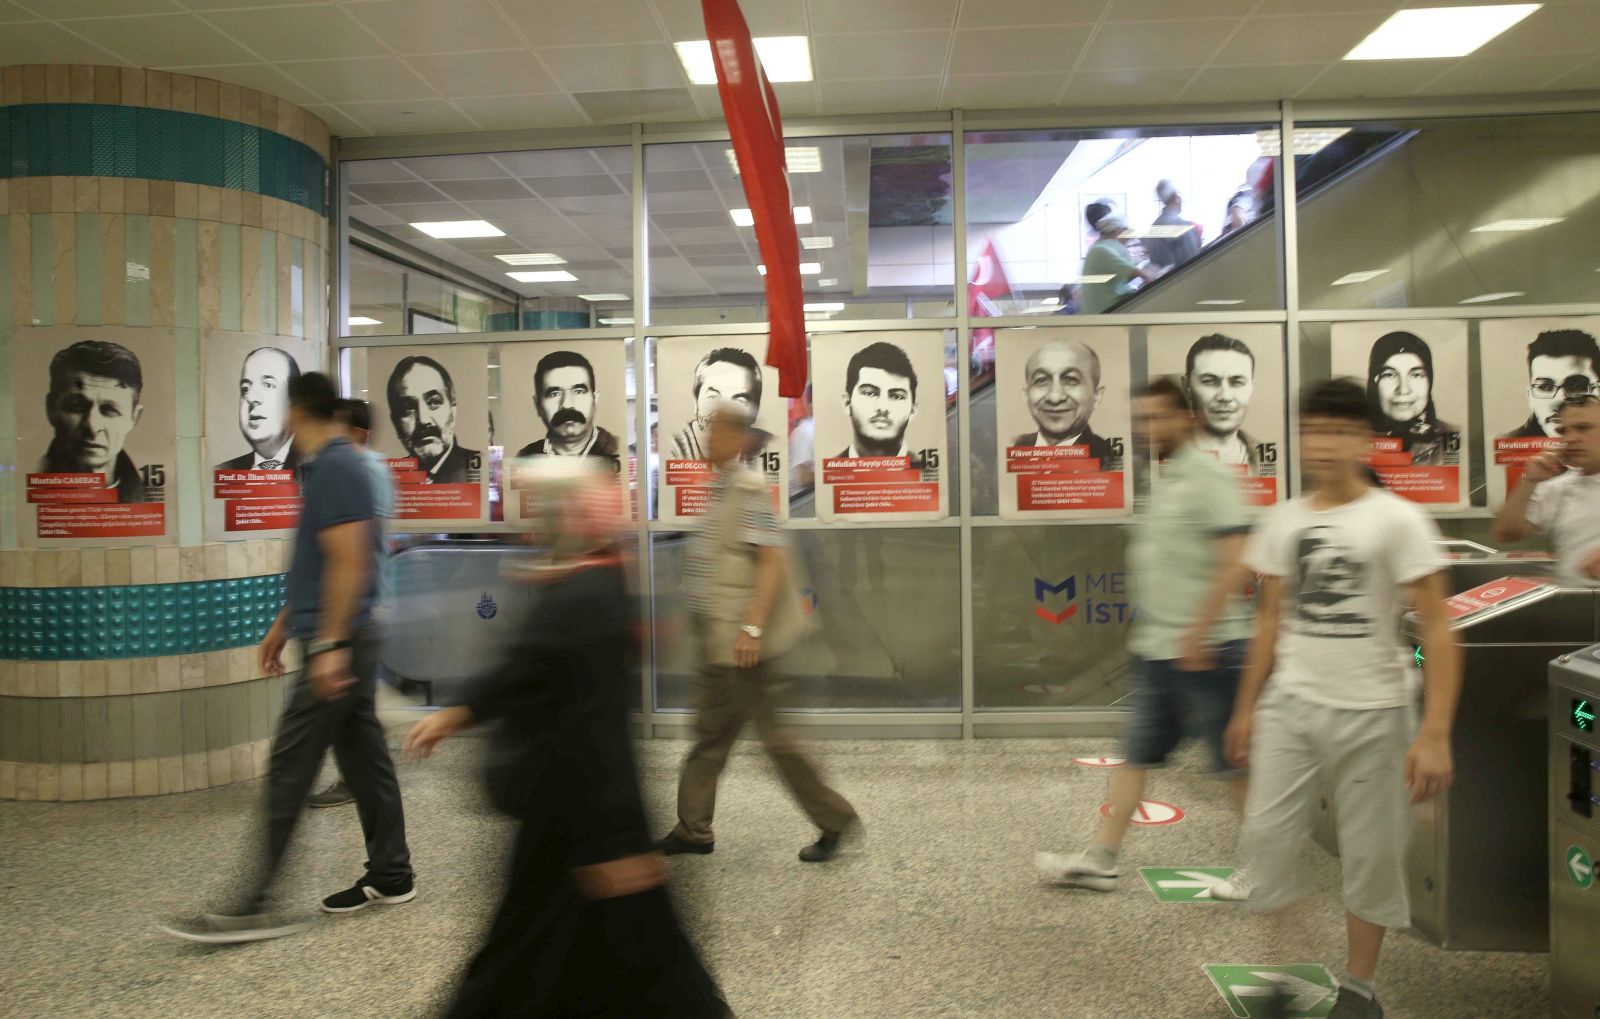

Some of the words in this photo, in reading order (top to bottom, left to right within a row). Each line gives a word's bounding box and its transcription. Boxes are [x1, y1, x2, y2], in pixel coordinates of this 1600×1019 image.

[1054, 448, 1085, 456] ÖZTÜRK
[1104, 437, 1124, 456] 15
[1256, 443, 1276, 462] 15
[684, 462, 708, 470] OLÇOK
[759, 452, 780, 472] 15
[858, 460, 880, 468] Tayyip
[881, 459, 905, 468] OLÇOK
[918, 448, 938, 468] 15
[138, 464, 165, 487] 15
[248, 472, 264, 480] İlhan
